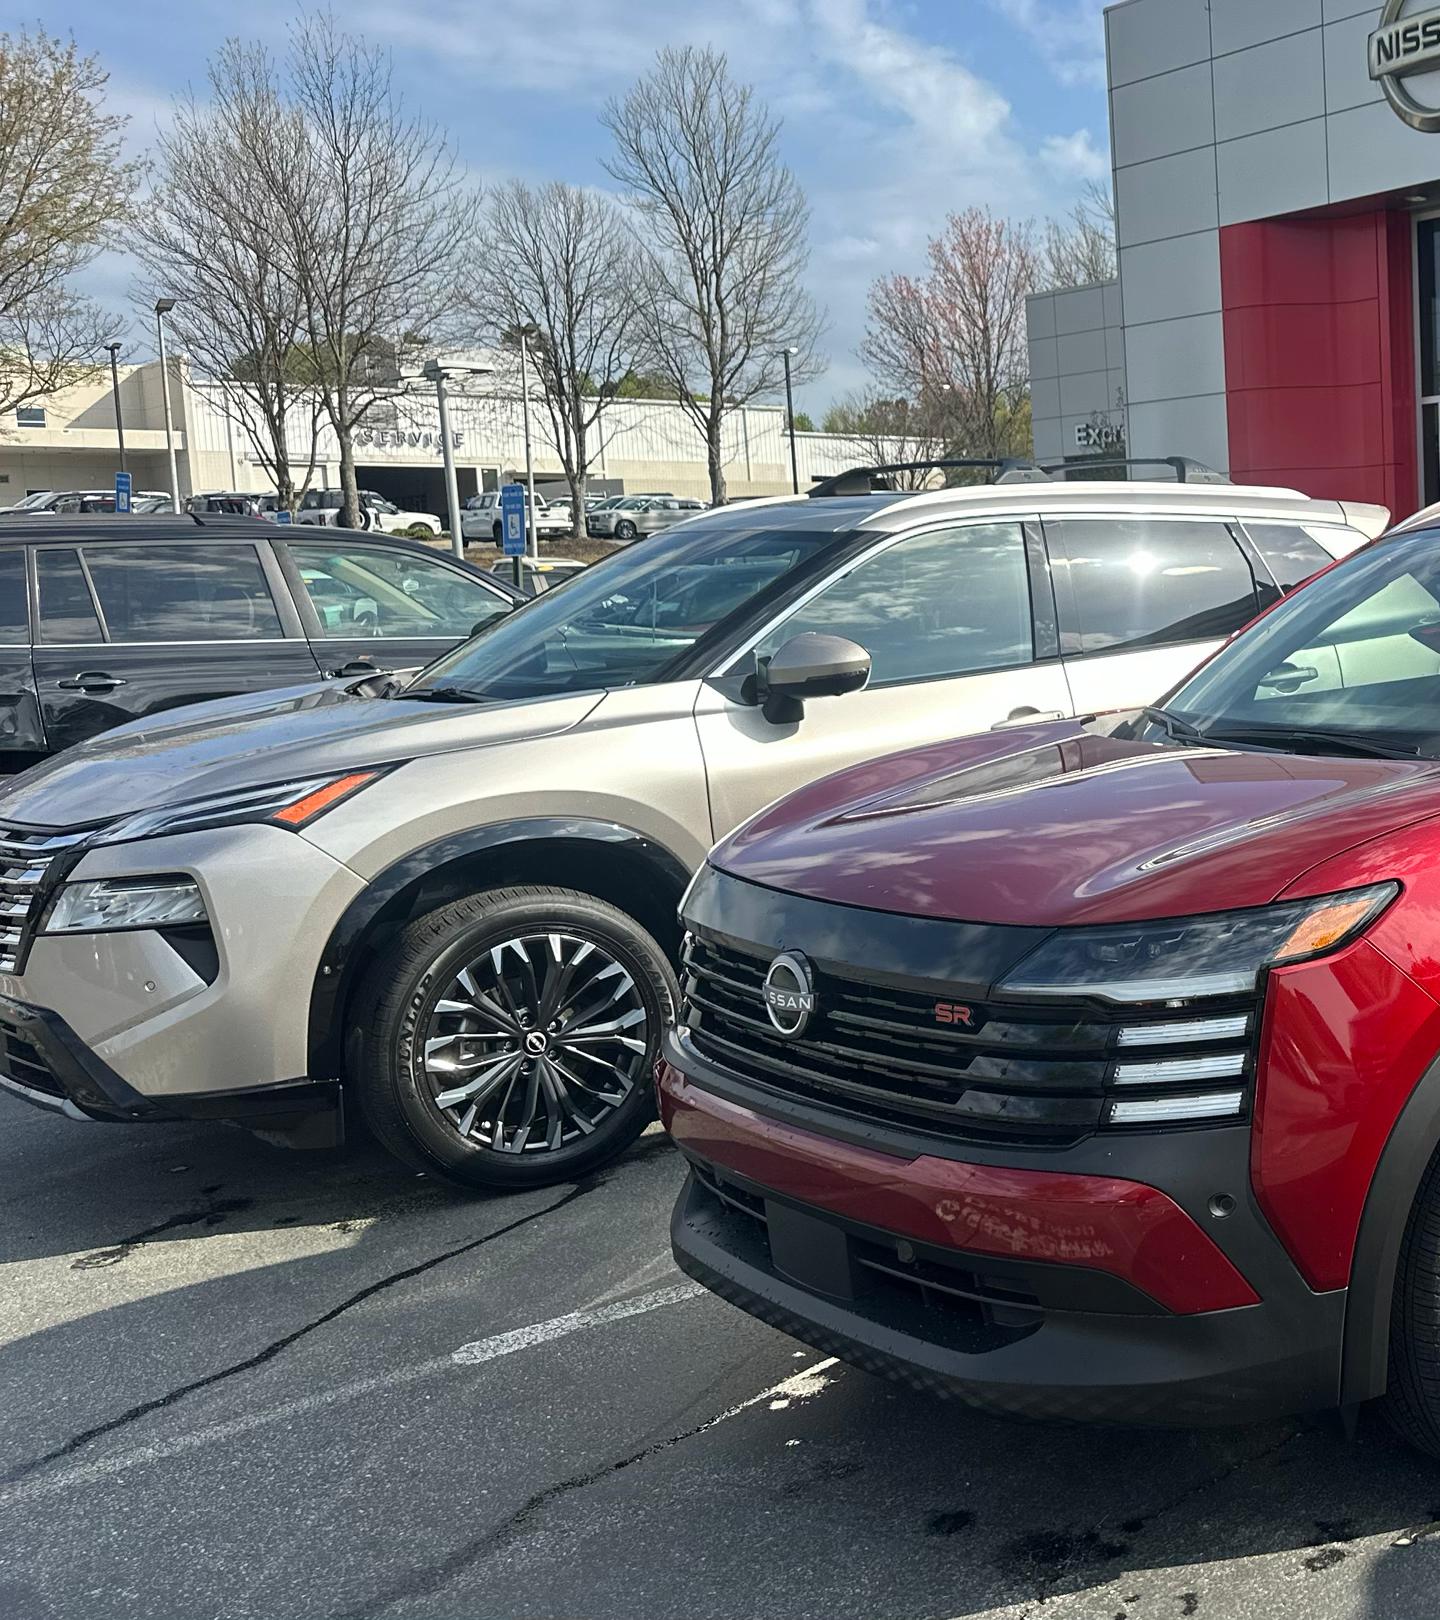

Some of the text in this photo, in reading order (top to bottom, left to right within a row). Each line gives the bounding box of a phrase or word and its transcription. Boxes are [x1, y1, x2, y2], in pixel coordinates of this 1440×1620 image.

[362, 428, 465, 447] SERVIE
[934, 1003, 974, 1025] SR
[400, 972, 432, 1082] DUNLOP
